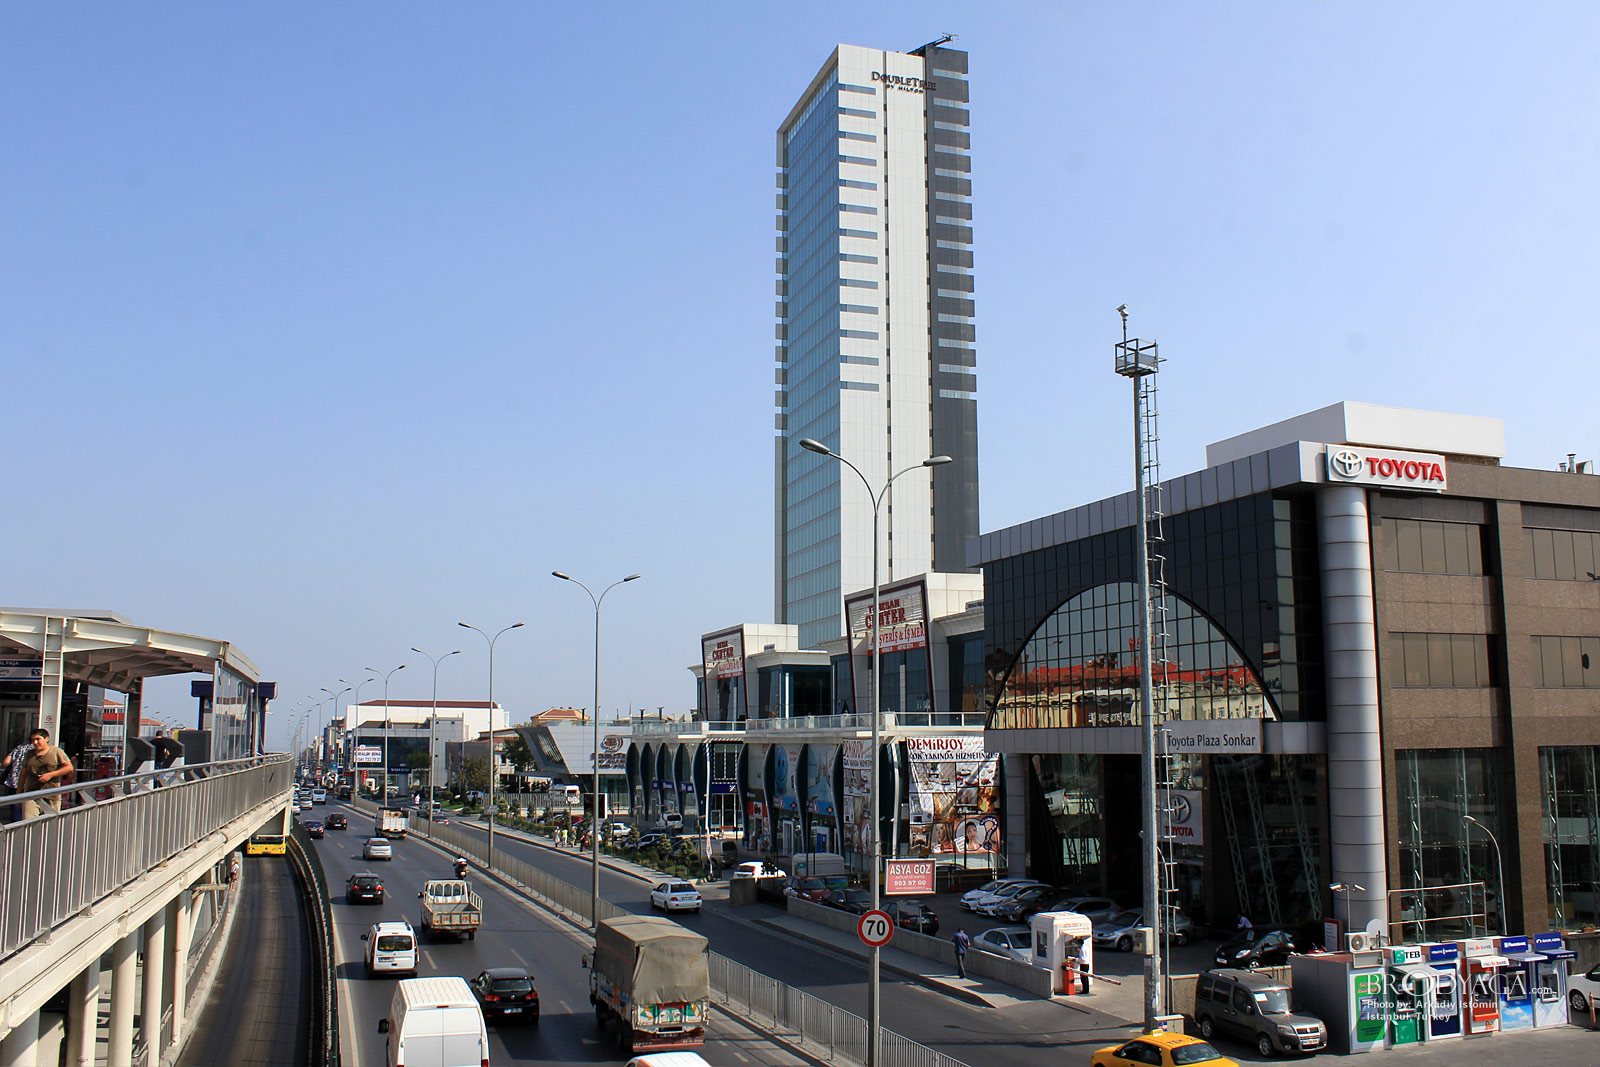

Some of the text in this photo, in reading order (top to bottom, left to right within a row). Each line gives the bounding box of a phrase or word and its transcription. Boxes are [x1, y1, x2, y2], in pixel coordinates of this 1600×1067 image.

[898, 86, 924, 94] HILTON
[1366, 457, 1444, 481] TOYOTA
[1167, 733, 1256, 750] Toyota Plaza Sonkar
[890, 864, 911, 875] ASYA
[866, 920, 886, 936] 70
